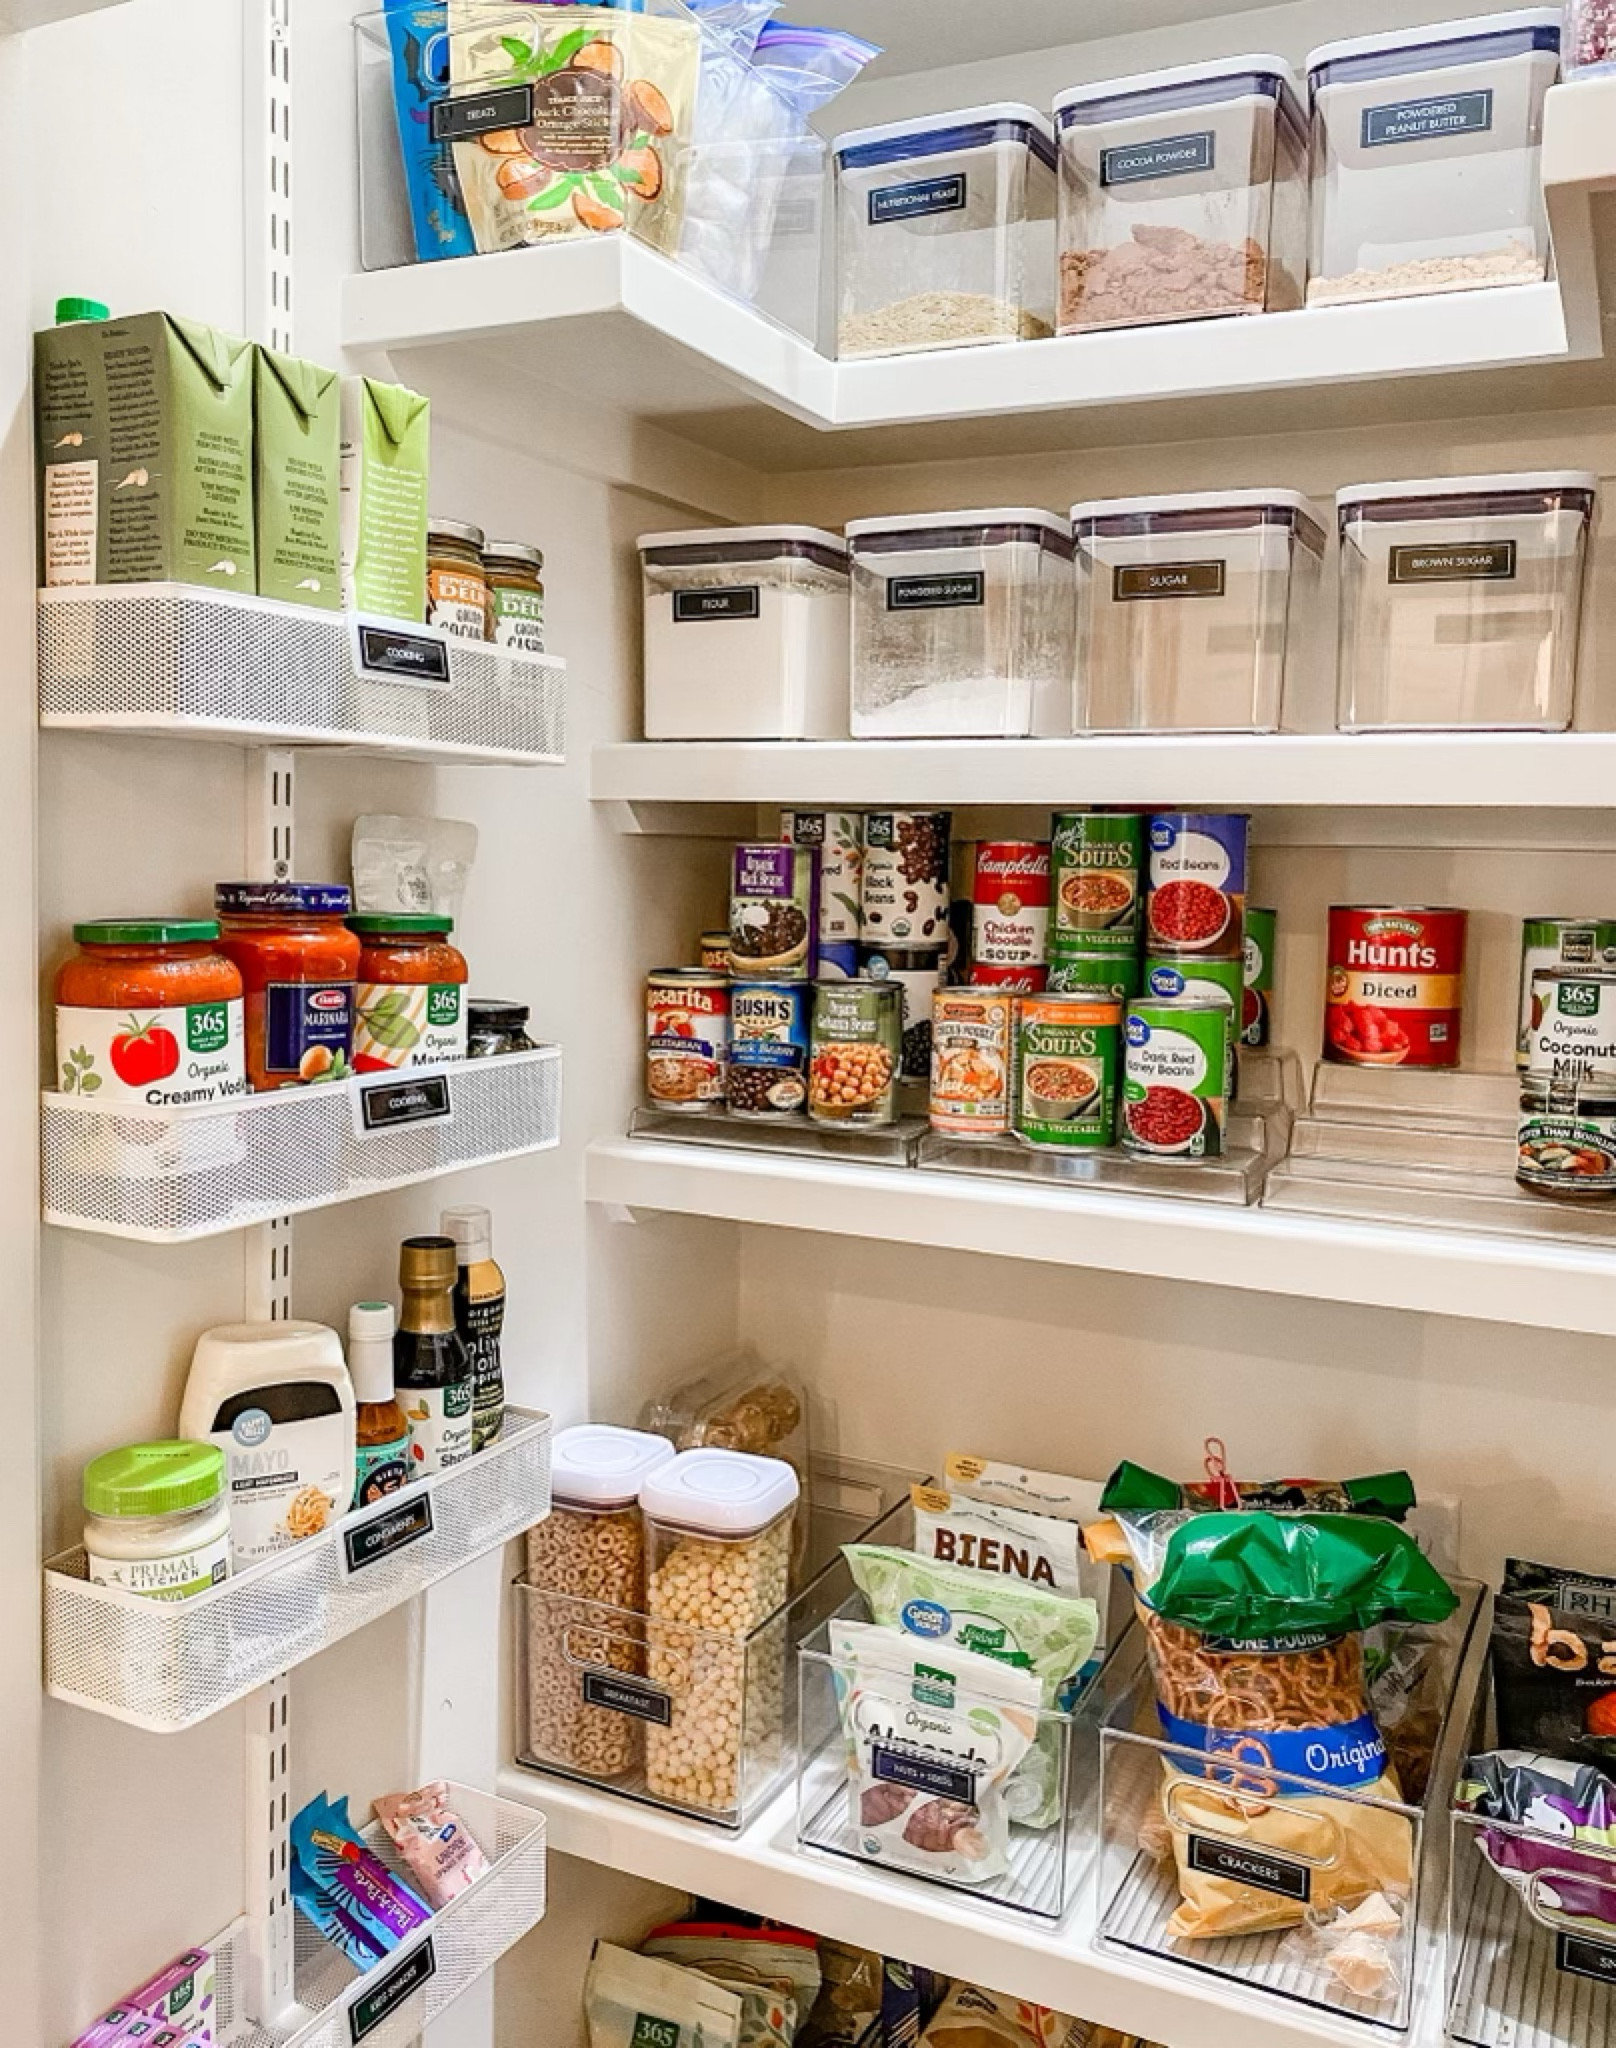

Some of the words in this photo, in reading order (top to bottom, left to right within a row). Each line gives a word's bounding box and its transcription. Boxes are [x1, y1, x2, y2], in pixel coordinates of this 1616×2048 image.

[466, 107, 497, 121] TREATS
[1398, 102, 1457, 121] POWDERED
[1385, 119, 1427, 135] PEANUT
[1429, 115, 1467, 129] BUTTER
[1117, 156, 1153, 169] COCOA
[1155, 148, 1197, 163] POWDER
[1411, 557, 1453, 569] BROWN
[1456, 555, 1493, 567] SUGAR
[898, 586, 942, 598] POWDERED
[944, 583, 973, 596] SUGAR
[1149, 575, 1189, 587] SUGAR
[702, 598, 729, 609] FLOUR
[386, 646, 425, 663] COOKING
[1065, 841, 1133, 867] SOUPS
[1159, 857, 1180, 871] Red
[1183, 859, 1219, 871] Beans
[983, 919, 1035, 933] Chicken
[985, 933, 1033, 947] Noodle
[984, 948, 1031, 961] SOUP
[1362, 981, 1418, 999] Diced
[1561, 985, 1596, 1005] 365
[430, 990, 457, 1012] 365
[734, 998, 791, 1019] BUSH'S
[191, 1009, 226, 1036] 365
[303, 1010, 349, 1026] MARINARA
[1553, 1020, 1599, 1038] Organic
[425, 1033, 459, 1050] Organic
[1028, 1028, 1097, 1056] SOUPS
[1539, 1037, 1616, 1057] Coconut
[1141, 1050, 1168, 1062] Dark
[1171, 1051, 1195, 1063] Red
[187, 1060, 230, 1080] Organic
[1157, 1062, 1195, 1076] Beans
[1553, 1058, 1595, 1080] Milk
[145, 1086, 216, 1107] Creamy
[389, 1092, 427, 1110] COOKING
[467, 1335, 500, 1354] oliv
[477, 1350, 500, 1372] oil
[231, 1449, 289, 1477] MAYO
[130, 1555, 199, 1579] PRIMAL
[933, 1527, 1058, 1589] BIENA
[130, 1569, 199, 1588] KITCHEN
[905, 1711, 953, 1735] Organic
[1217, 1853, 1280, 1882] CRACKERS
[636, 2020, 675, 2048] 365
